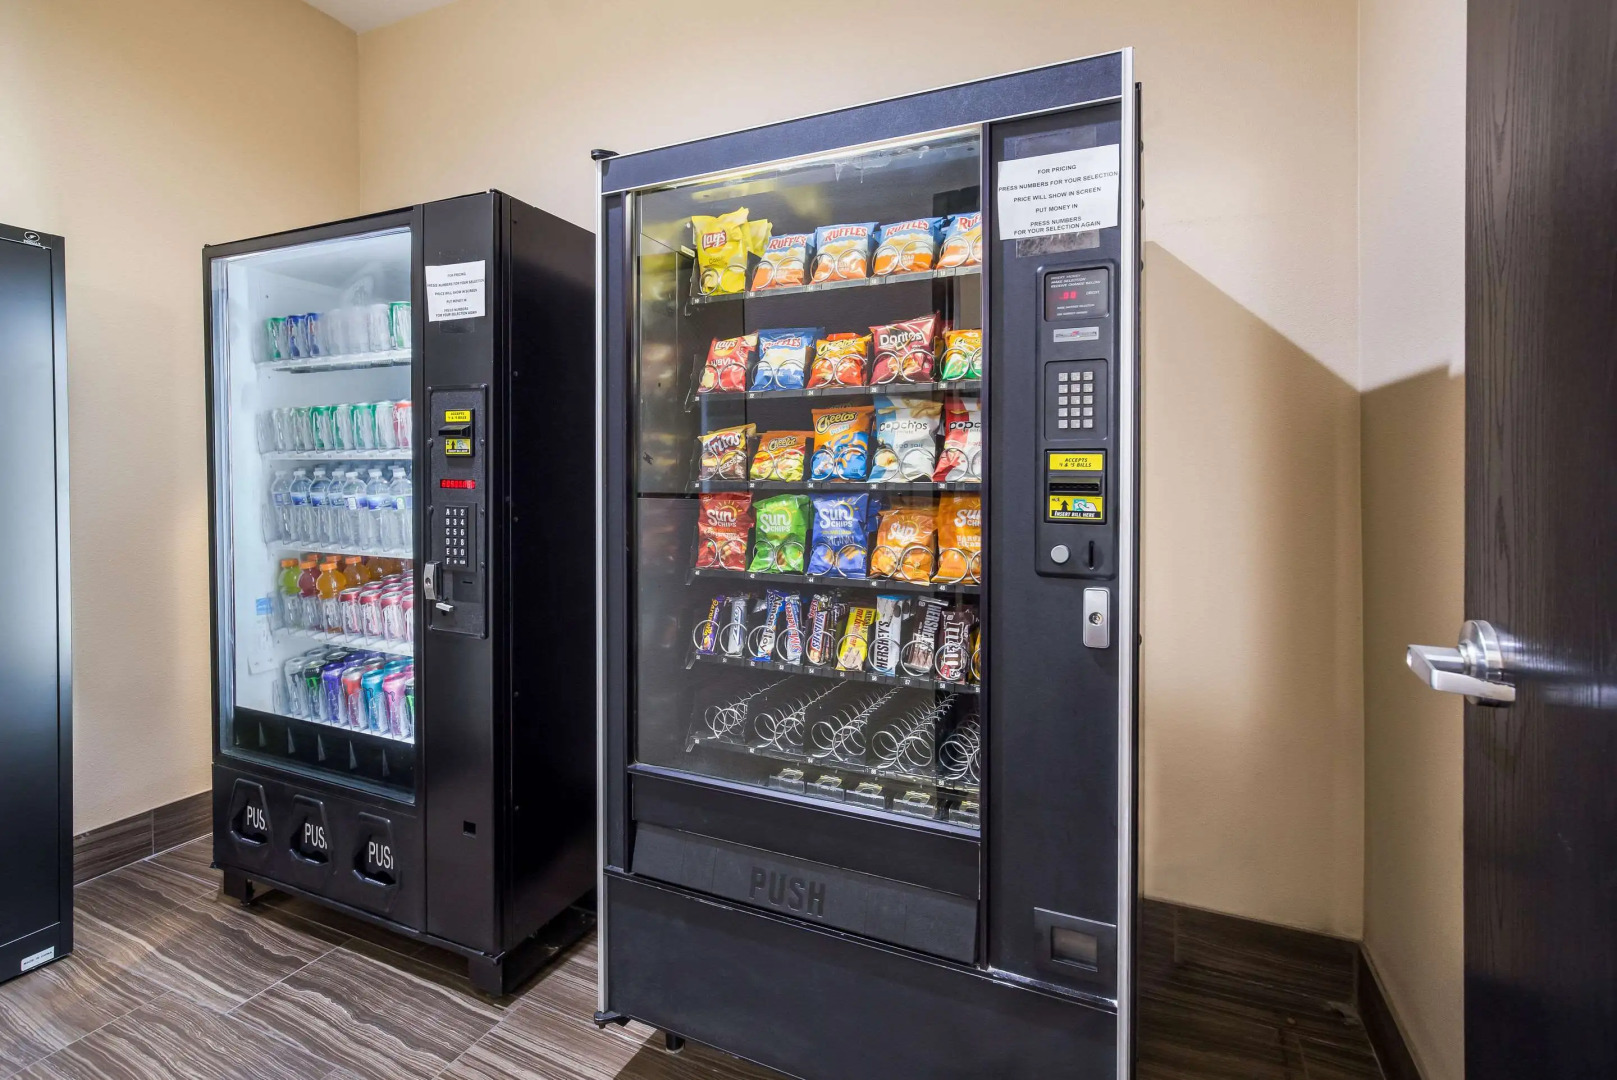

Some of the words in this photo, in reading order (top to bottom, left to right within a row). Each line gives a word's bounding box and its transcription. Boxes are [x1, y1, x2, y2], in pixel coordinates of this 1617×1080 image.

[1052, 164, 1077, 173] PRICING
[1083, 171, 1118, 181] SELECTION
[1076, 187, 1101, 195] SCREEN
[1052, 216, 1082, 224] NUMBERS
[825, 227, 867, 241] RUFFLES
[1046, 224, 1079, 232] SELECTION
[880, 331, 924, 344] Doritos
[816, 412, 857, 434] Cheetos
[880, 420, 928, 434] popchips
[706, 509, 736, 526] Sun
[760, 512, 791, 533] Sun
[819, 508, 853, 528] Sun
[876, 620, 890, 668] HERSHEY'S
[246, 805, 267, 831] PUS
[305, 823, 327, 850] PUS
[749, 866, 826, 918] PUSH
